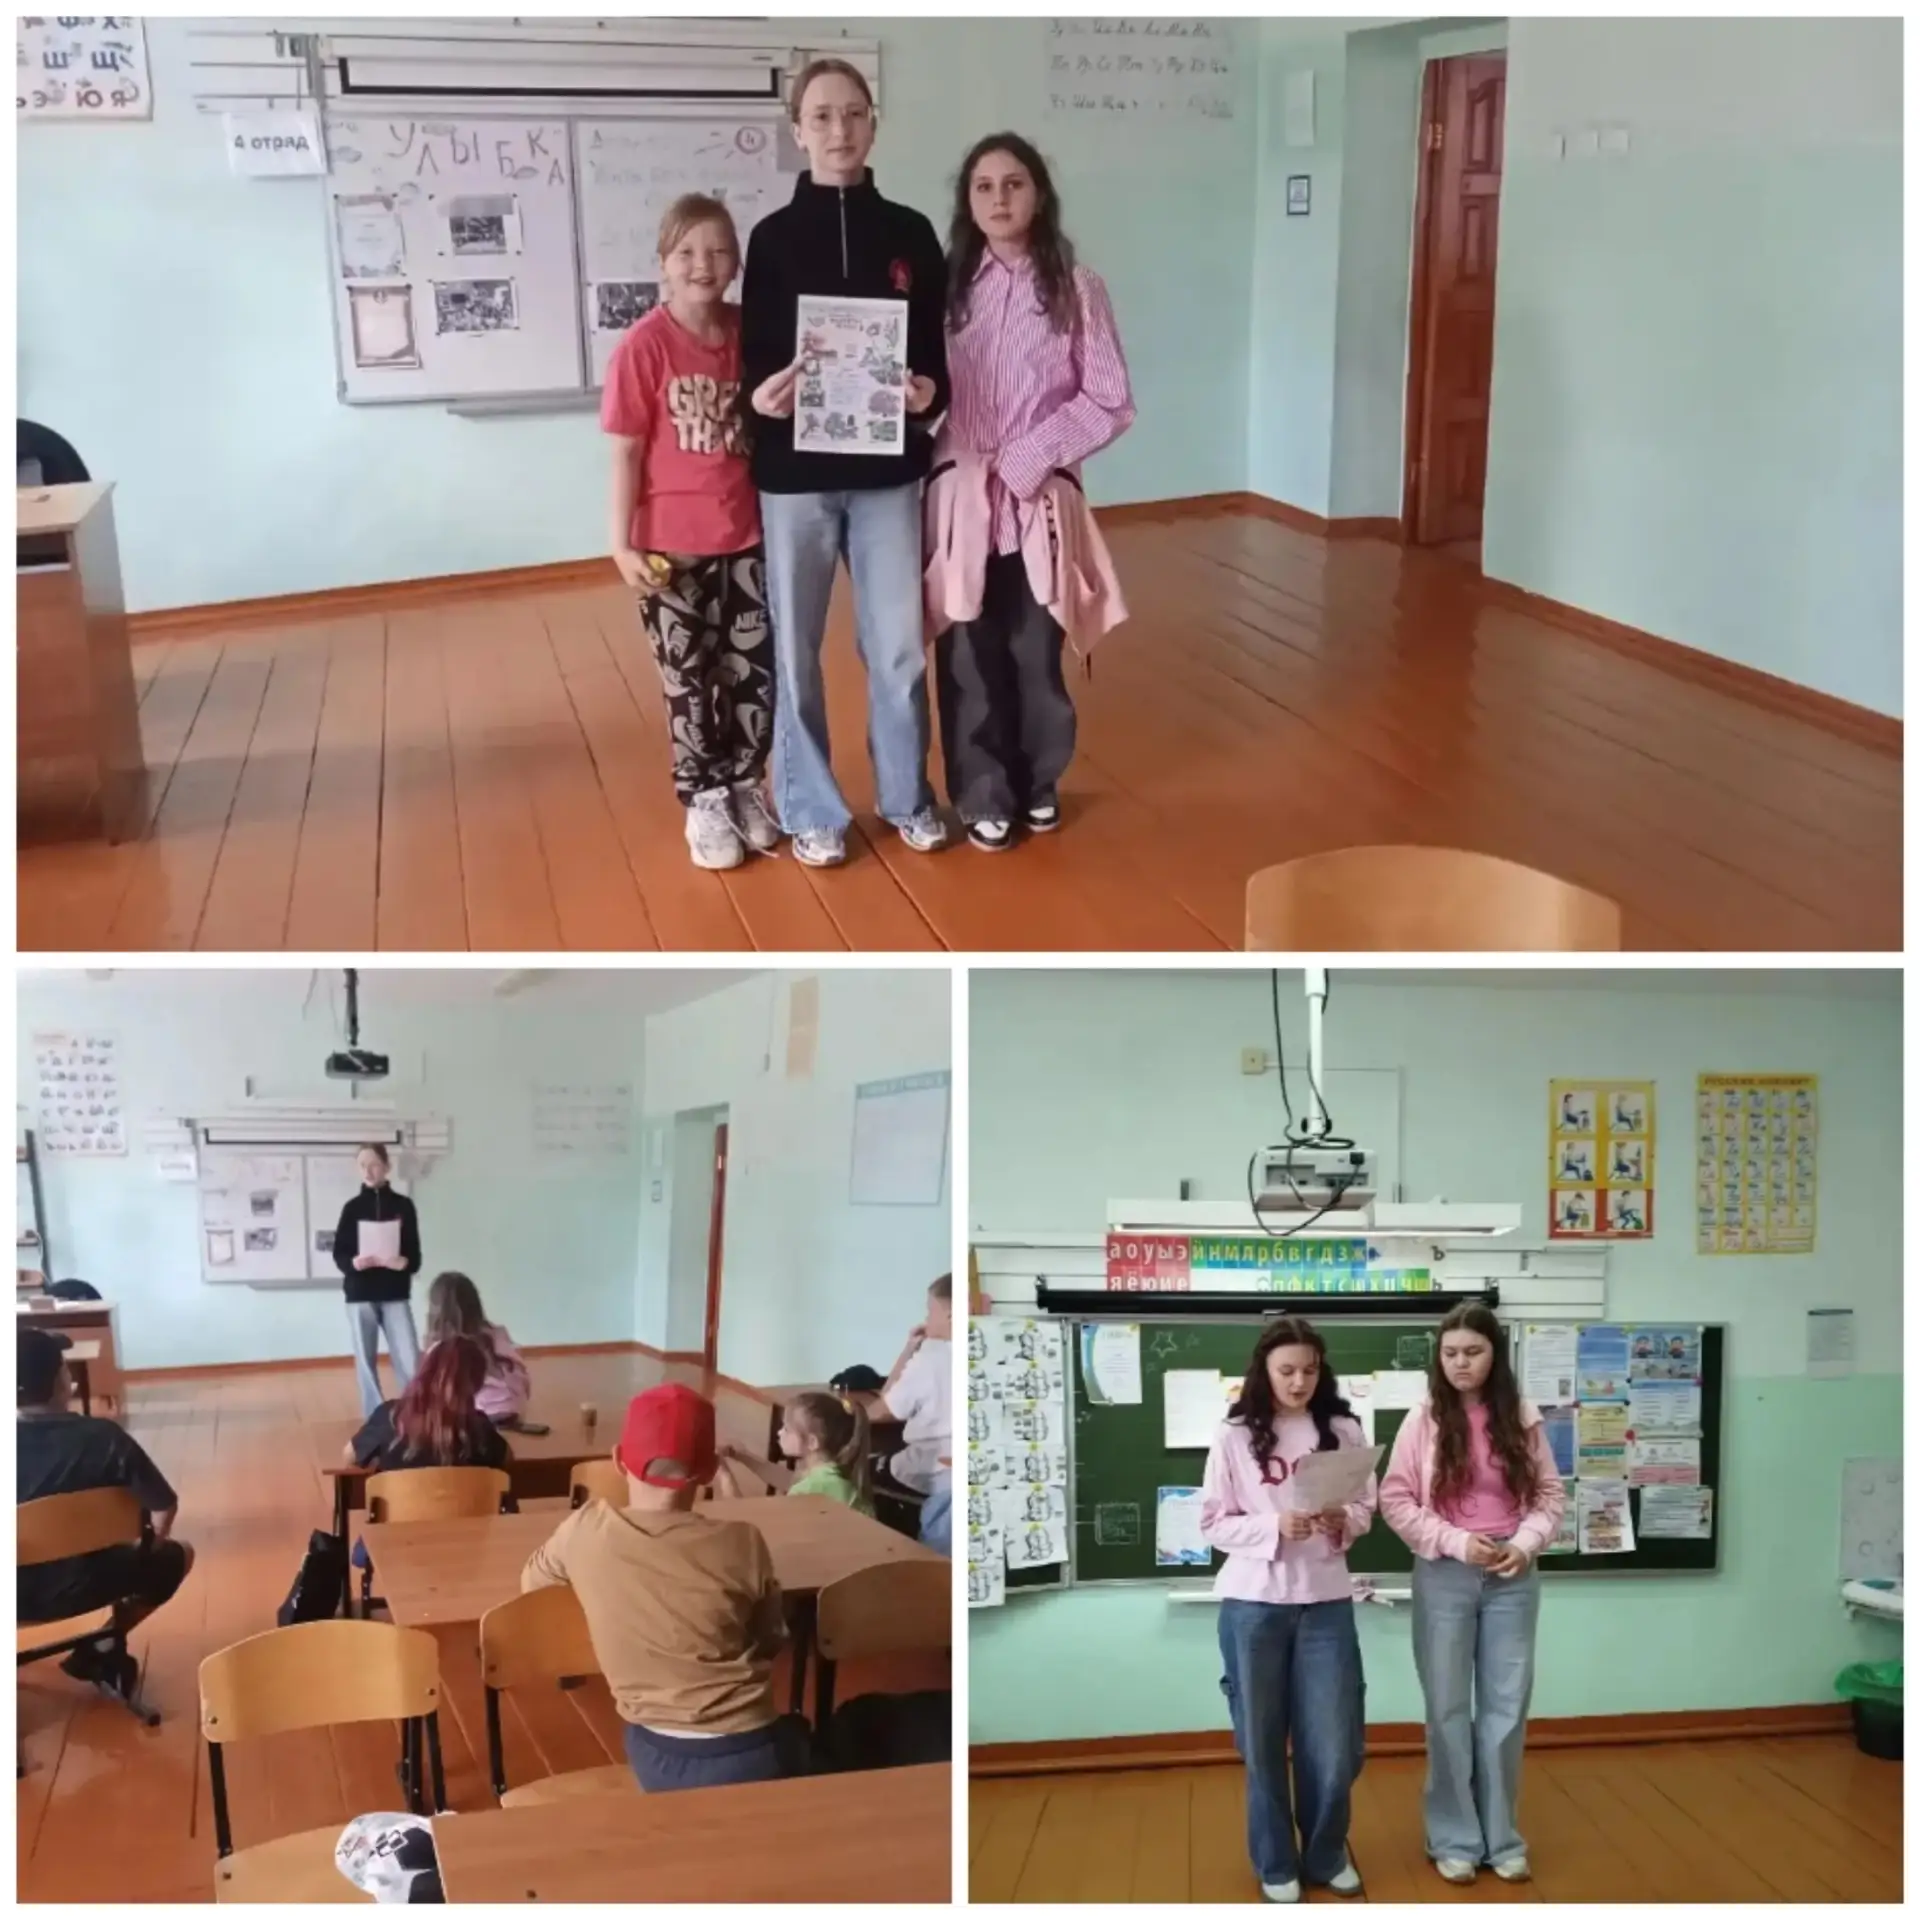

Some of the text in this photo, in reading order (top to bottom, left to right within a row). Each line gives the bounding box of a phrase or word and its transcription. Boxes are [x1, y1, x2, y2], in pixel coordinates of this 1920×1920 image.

[76, 89, 103, 108] Ю
[251, 136, 310, 152] отряд
[1260, 1456, 1299, 1486] D
